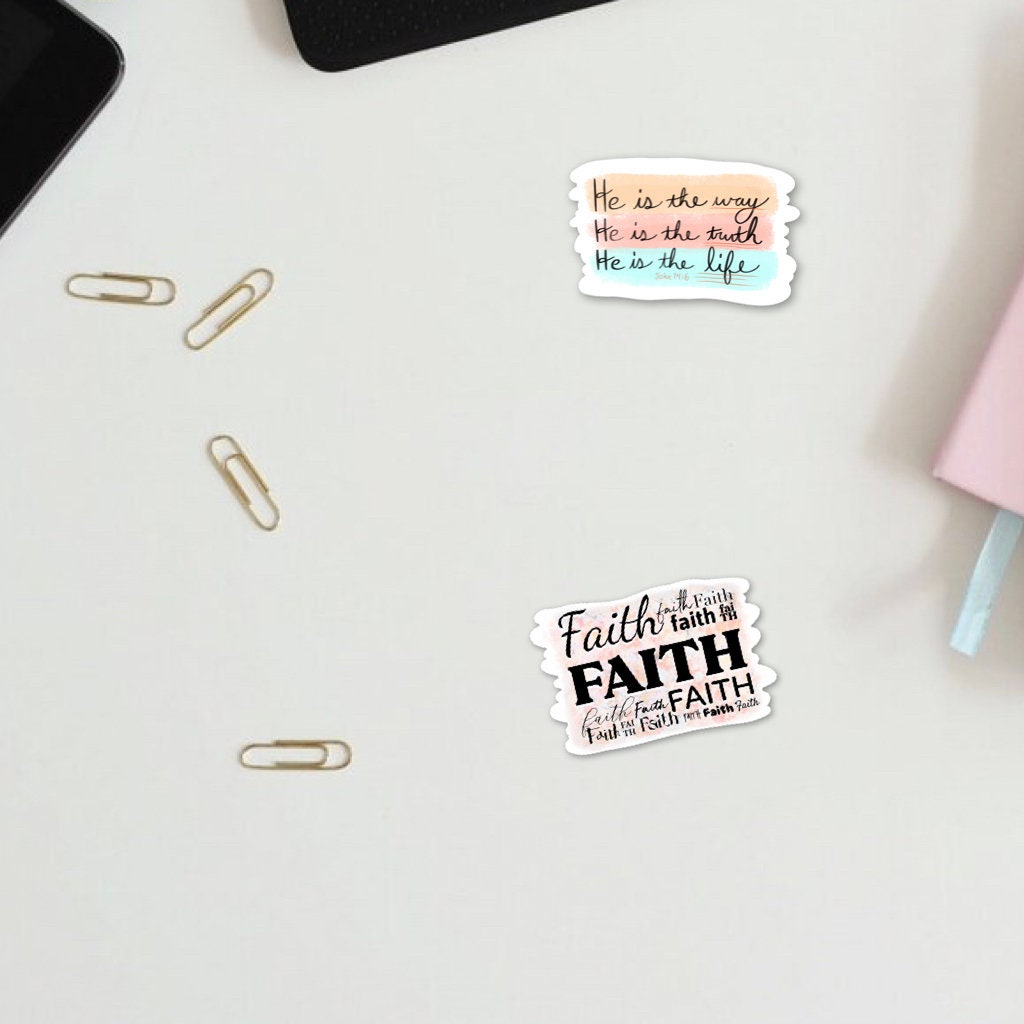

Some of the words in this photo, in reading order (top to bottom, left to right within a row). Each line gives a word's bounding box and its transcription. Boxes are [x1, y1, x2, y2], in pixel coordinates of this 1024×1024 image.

[592, 178, 626, 212] He
[633, 188, 663, 210] is
[667, 187, 708, 209] the
[712, 196, 770, 224] way
[594, 218, 624, 243] He
[630, 222, 658, 241] is
[661, 219, 701, 242] the
[706, 216, 763, 245] truth
[595, 249, 626, 271] He
[629, 251, 653, 270] is
[658, 247, 695, 270] the
[704, 246, 760, 285] life
[557, 594, 665, 658] Faith
[671, 607, 716, 632] faith
[568, 628, 748, 706] FAITH
[634, 700, 671, 718] Faith
[668, 673, 755, 712] FAITH
[586, 723, 621, 744] Faith
[703, 703, 735, 718] Faith
